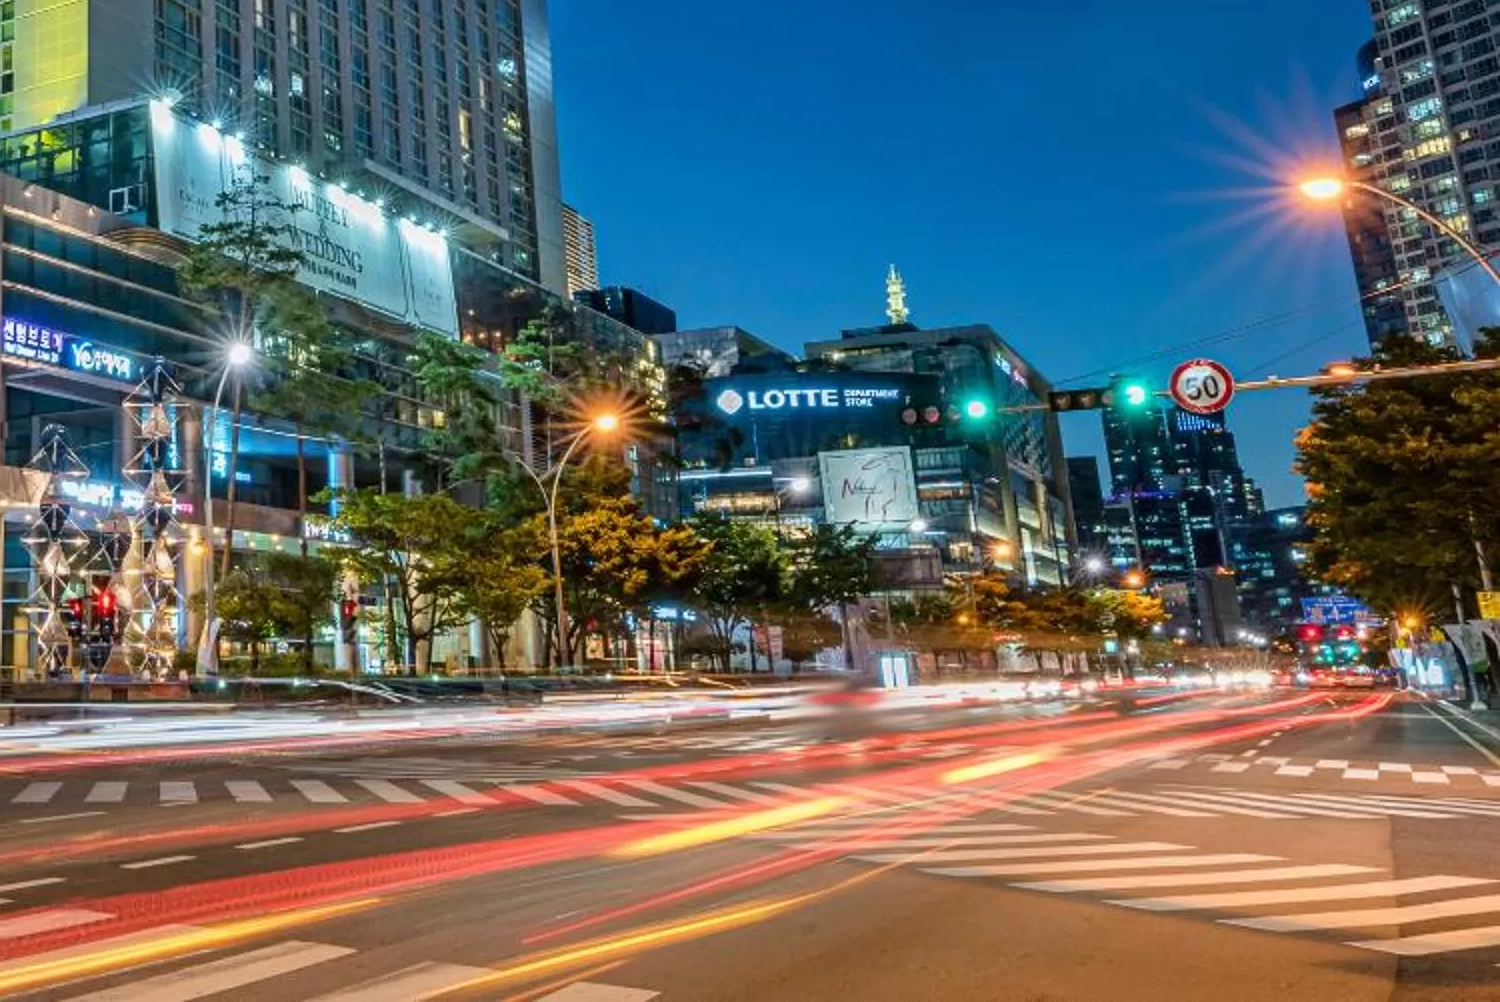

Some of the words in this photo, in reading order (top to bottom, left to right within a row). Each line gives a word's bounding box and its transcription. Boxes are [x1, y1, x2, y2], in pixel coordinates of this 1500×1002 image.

[289, 225, 363, 273] WEDDING
[1186, 375, 1219, 400] 50
[748, 389, 839, 409] LOTTE
[844, 389, 899, 399] DEPARTMENT
[845, 398, 873, 407] STORE
